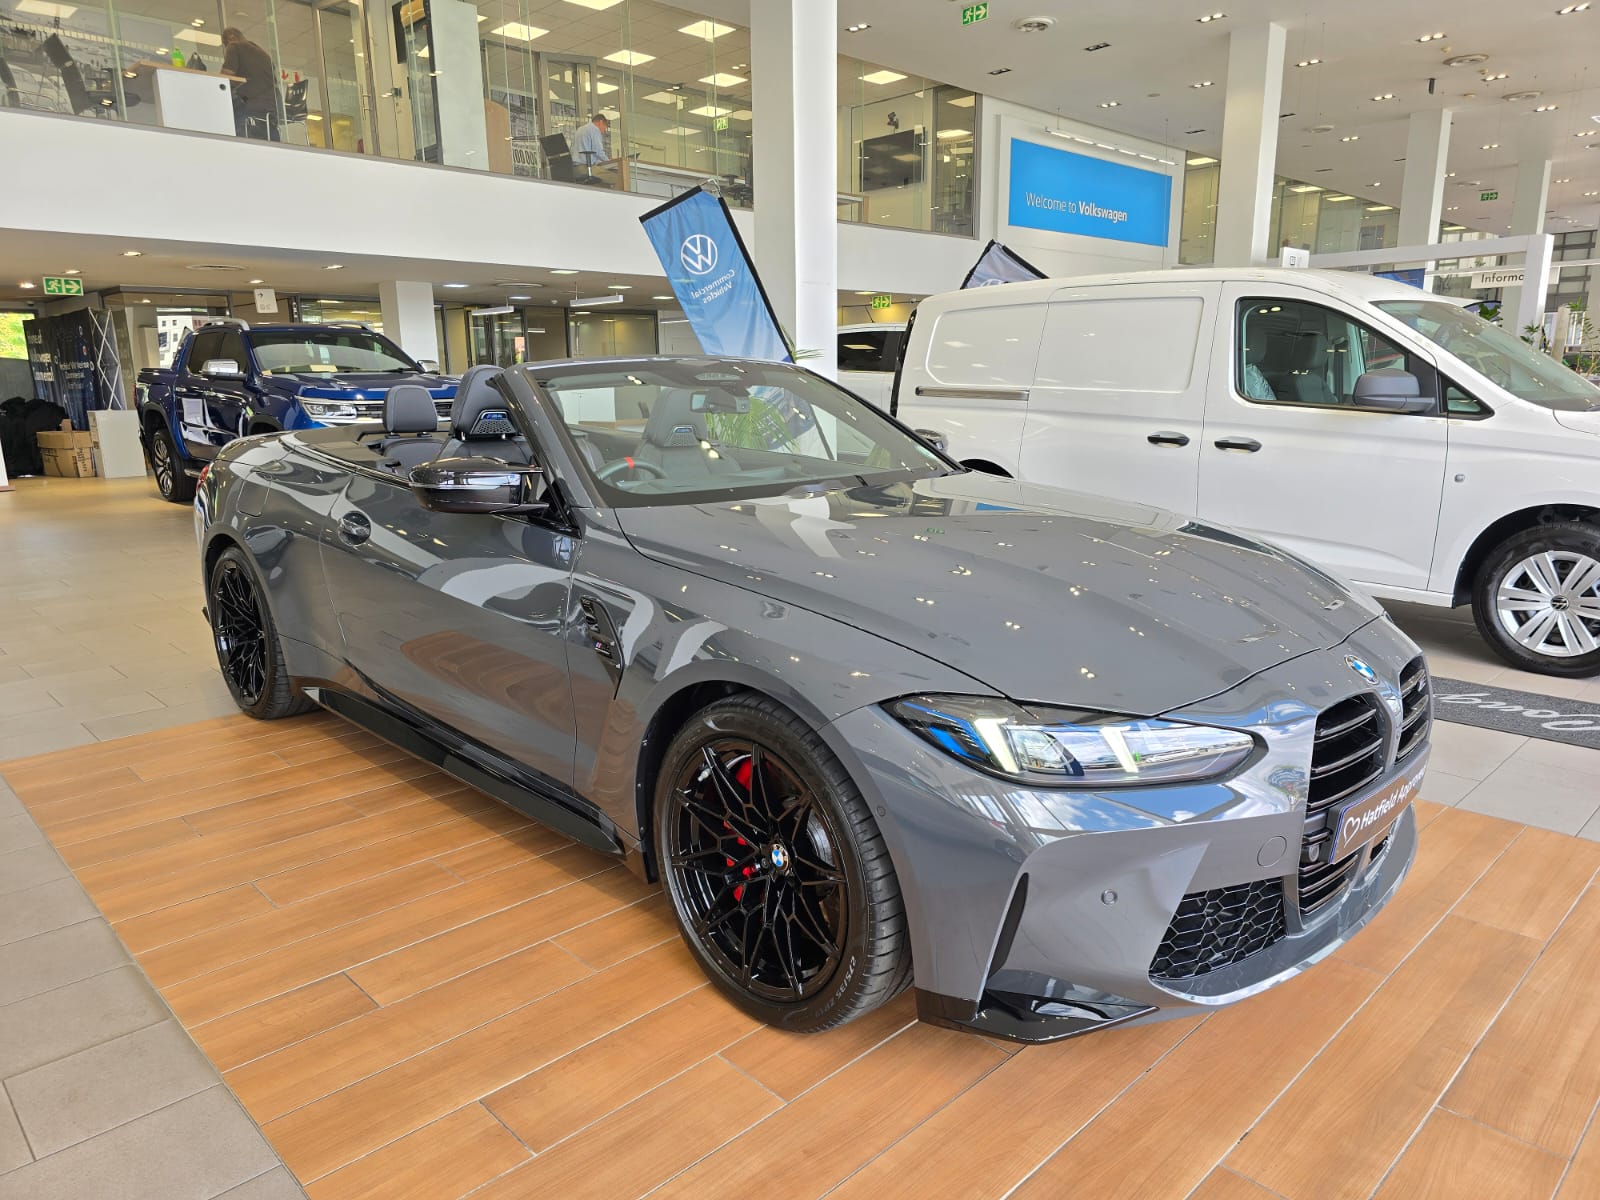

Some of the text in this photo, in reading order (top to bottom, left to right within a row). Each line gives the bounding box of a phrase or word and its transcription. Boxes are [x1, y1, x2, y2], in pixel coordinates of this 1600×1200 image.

[1025, 191, 1128, 224] Welcome to Volkswagen
[1360, 790, 1399, 830] Hatfield
